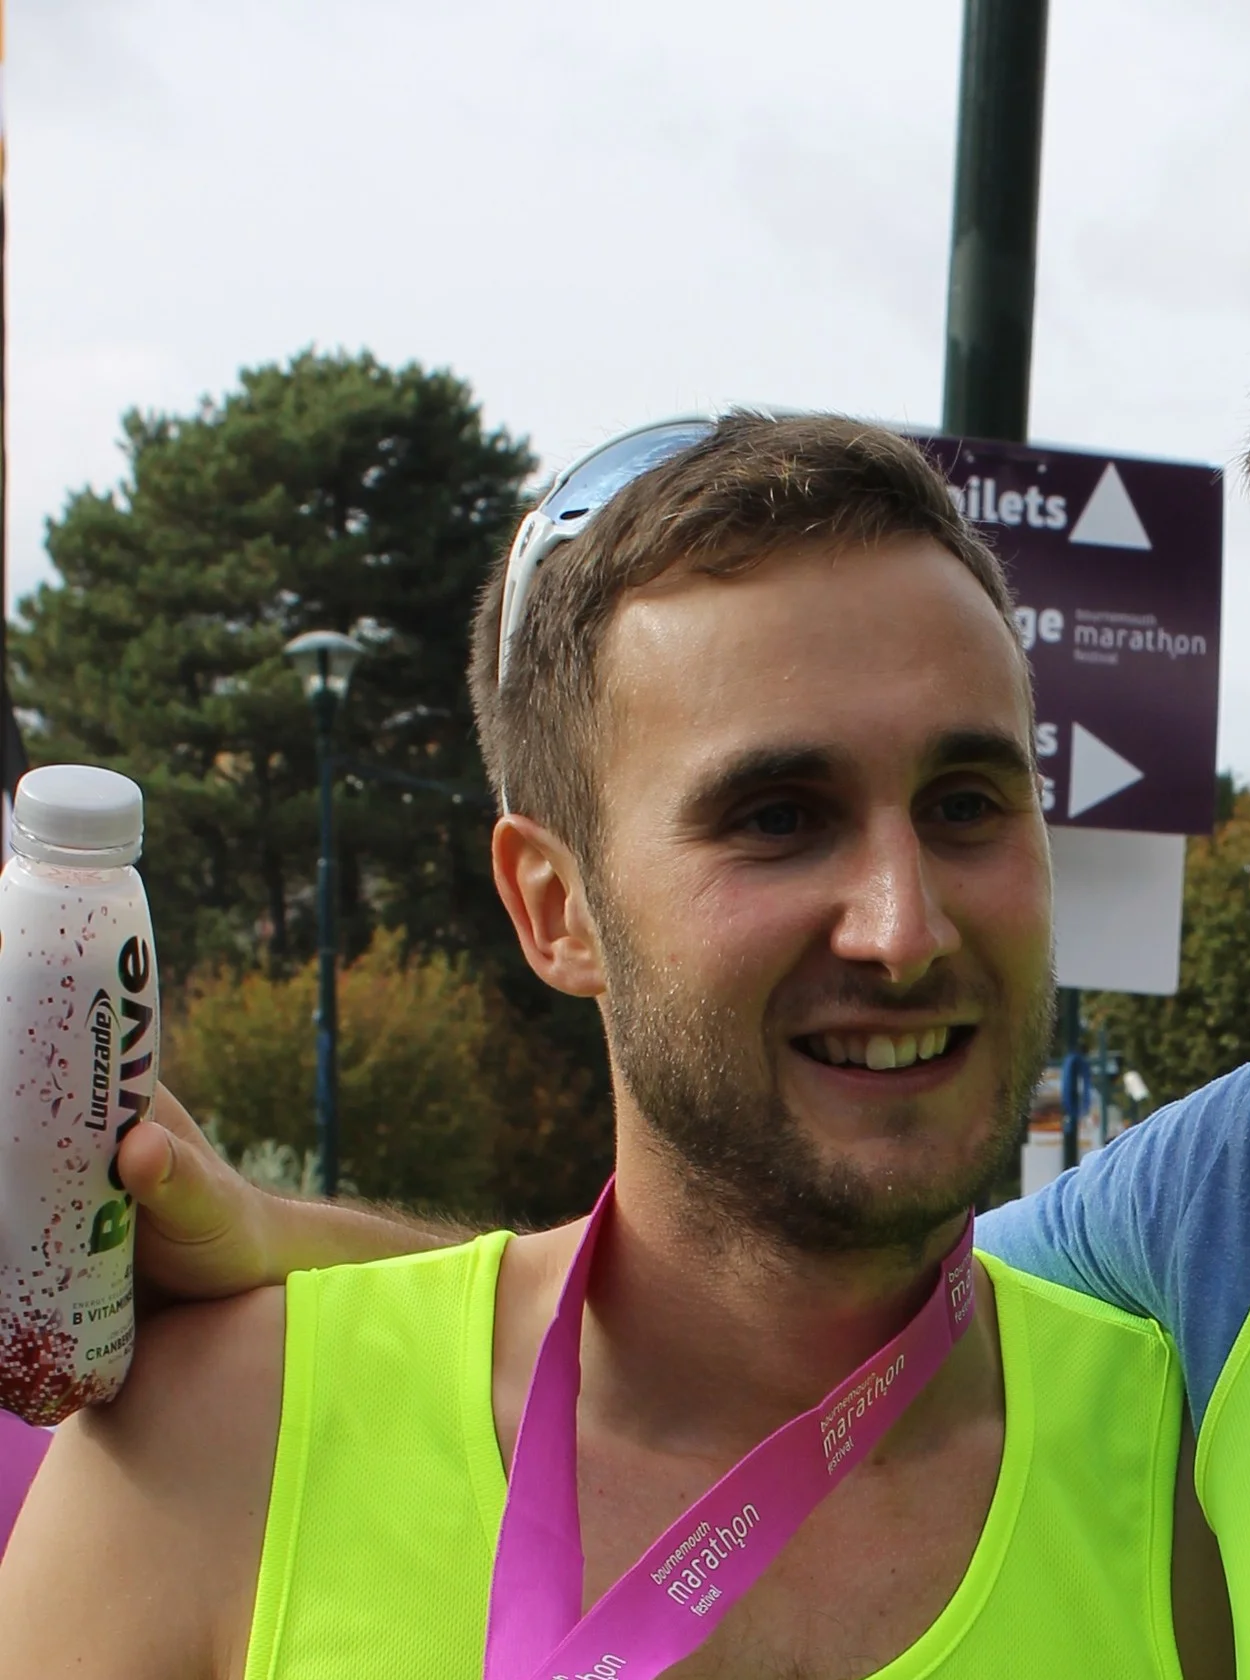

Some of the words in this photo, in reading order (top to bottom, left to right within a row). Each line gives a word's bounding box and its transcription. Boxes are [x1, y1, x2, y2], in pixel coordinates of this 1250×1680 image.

[85, 1007, 112, 1132] Lucozade
[72, 1312, 83, 1325] B
[650, 1521, 711, 1585] bournemouth
[690, 1584, 723, 1617] festival
